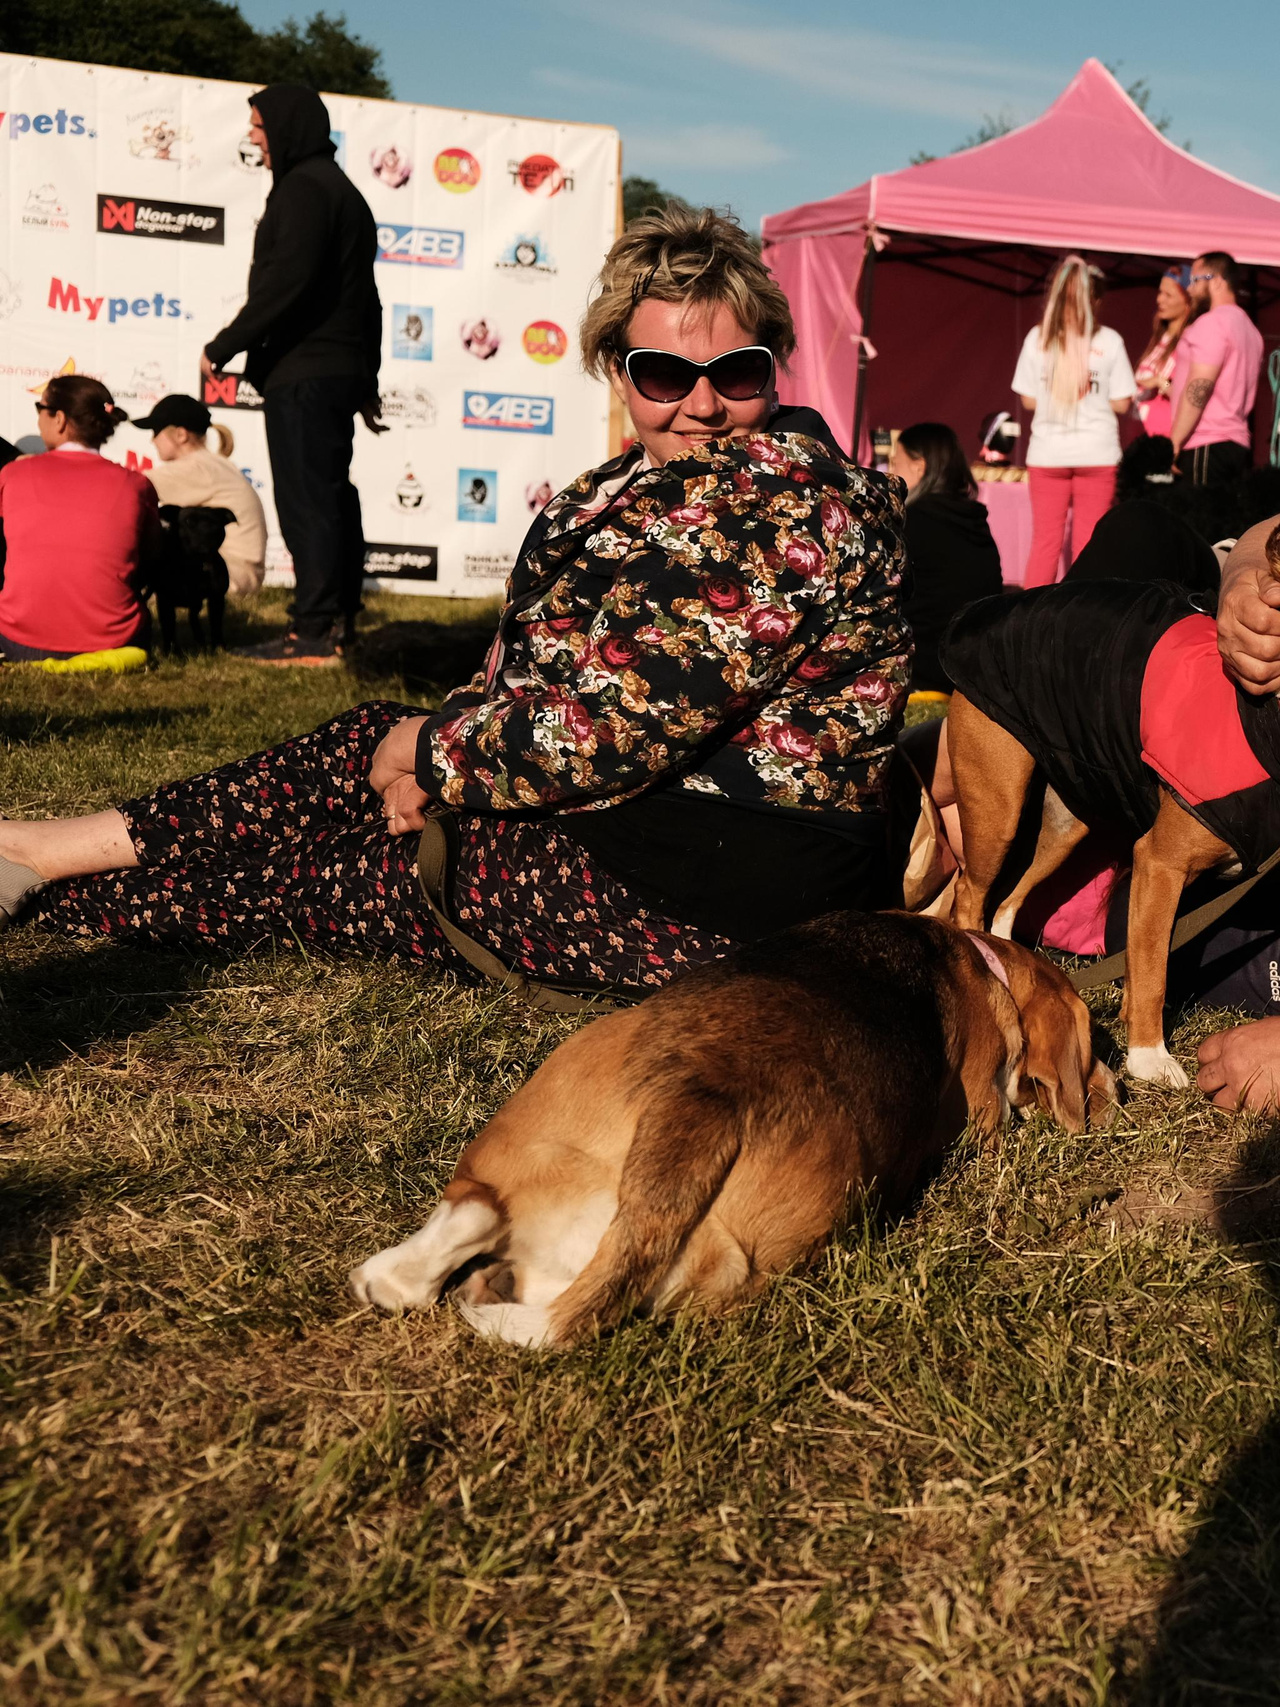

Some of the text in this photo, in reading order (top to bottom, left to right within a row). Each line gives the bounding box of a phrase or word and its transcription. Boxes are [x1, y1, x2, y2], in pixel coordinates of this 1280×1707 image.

[0, 108, 86, 140] pets
[137, 206, 218, 231] Non-stop
[364, 551, 432, 569] on-stop
[1269, 960, 1280, 1002] adidas
